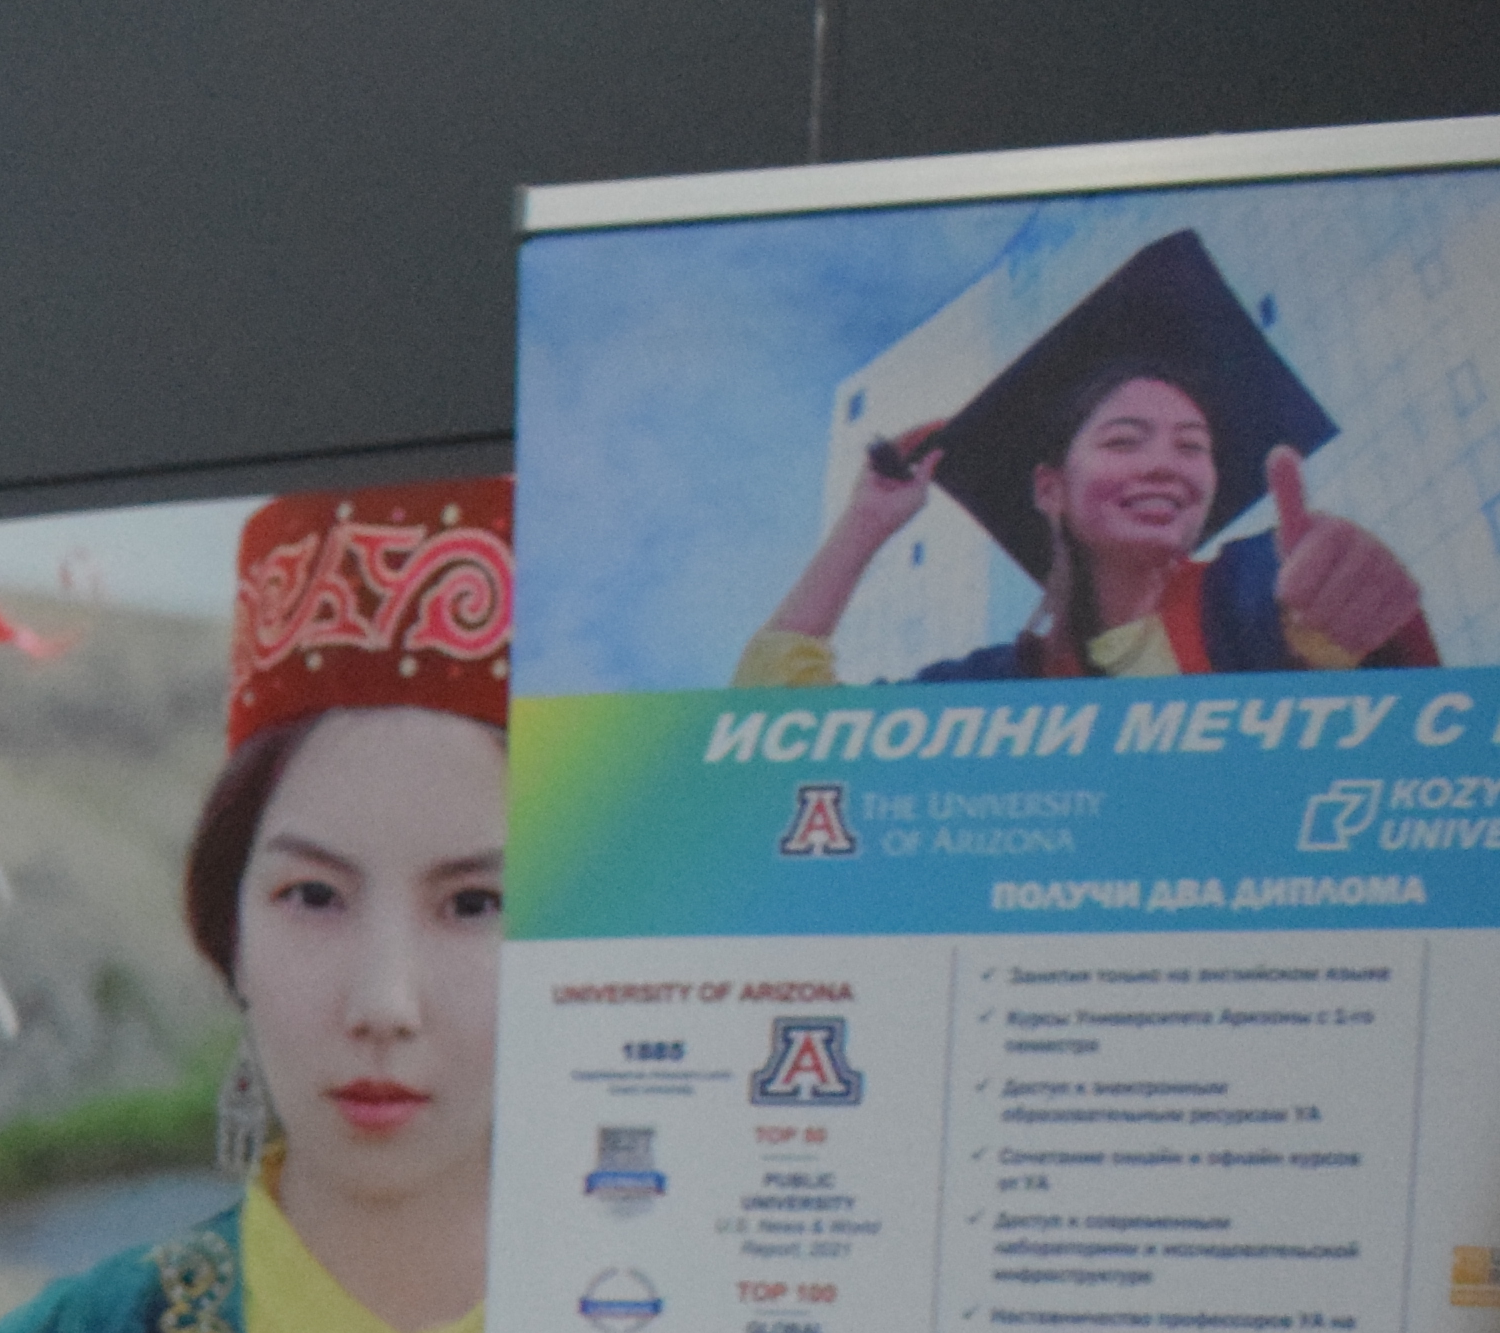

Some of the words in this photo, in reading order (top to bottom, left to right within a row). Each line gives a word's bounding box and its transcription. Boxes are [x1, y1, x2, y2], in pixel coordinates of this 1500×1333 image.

[702, 704, 1099, 763] ИСПОЛНИ
[1114, 695, 1398, 754] МЕЧТУ
[1414, 691, 1475, 746] С
[1390, 775, 1500, 810] KOZY
[779, 783, 858, 857] A
[1379, 818, 1500, 851] UNIVE
[991, 878, 1142, 911] ПОЛУЧИ
[1146, 877, 1225, 914] ДВА
[1230, 874, 1427, 912] ДИПЛОМА
[551, 981, 692, 1005] UNIVERSITY
[696, 981, 732, 1004] OF
[738, 981, 855, 1004] ARIZONA
[751, 1015, 863, 1105] A
